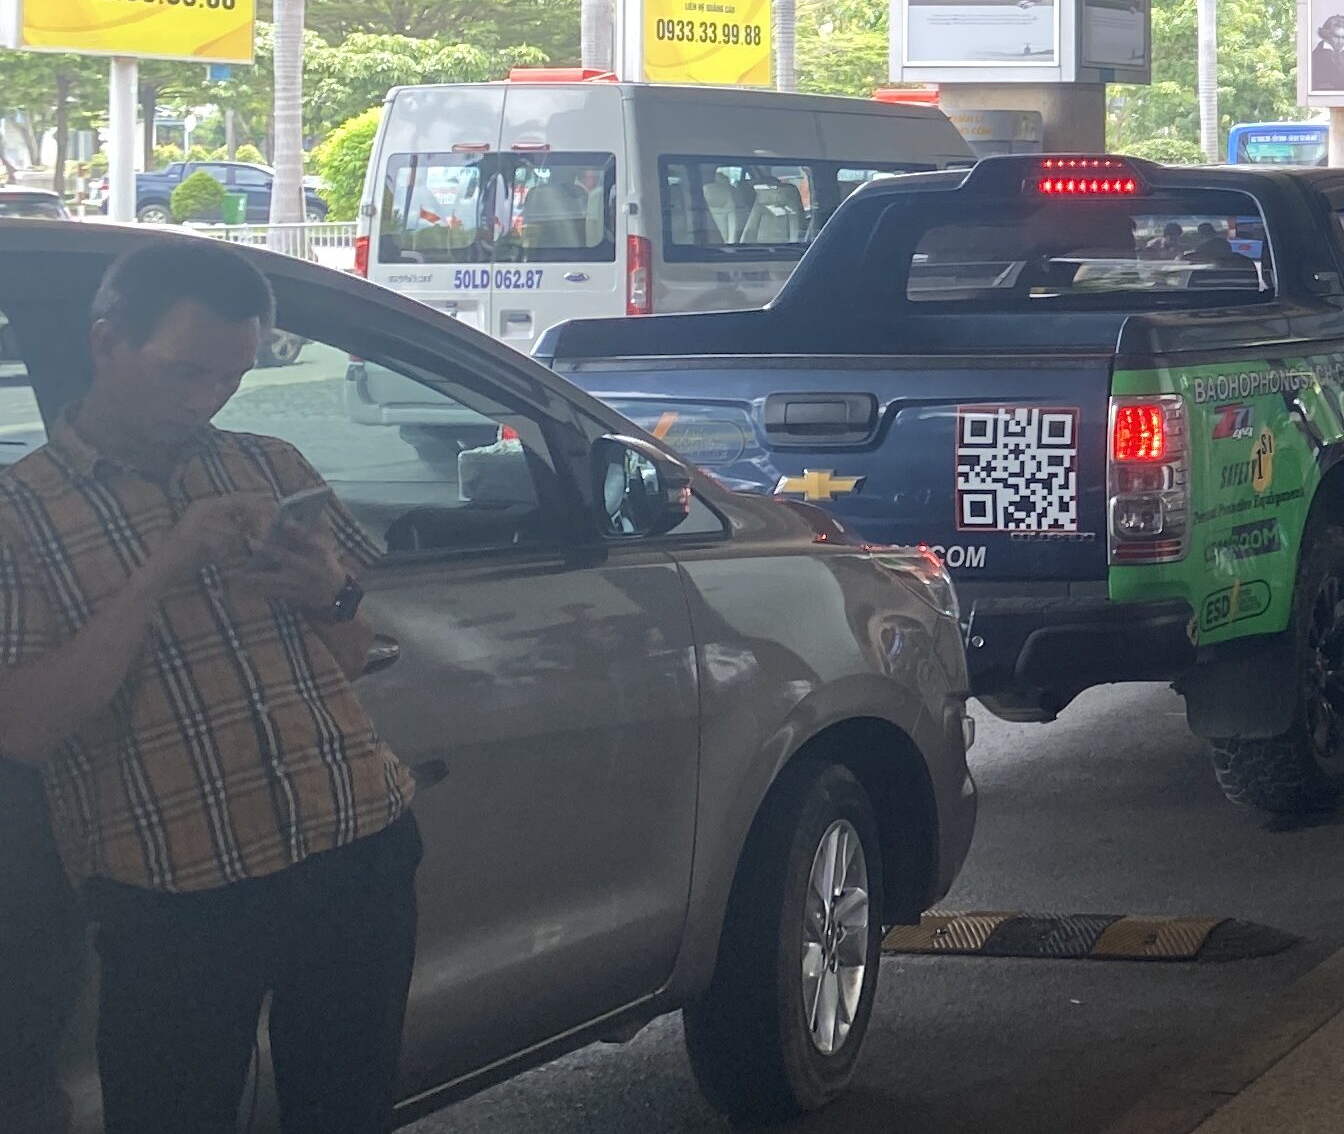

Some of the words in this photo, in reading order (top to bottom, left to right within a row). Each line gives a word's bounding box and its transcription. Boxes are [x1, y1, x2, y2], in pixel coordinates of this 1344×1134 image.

[656, 18, 762, 46] 0933.33.99.88
[453, 269, 490, 290] 50LD
[494, 269, 544, 290] 062.87
